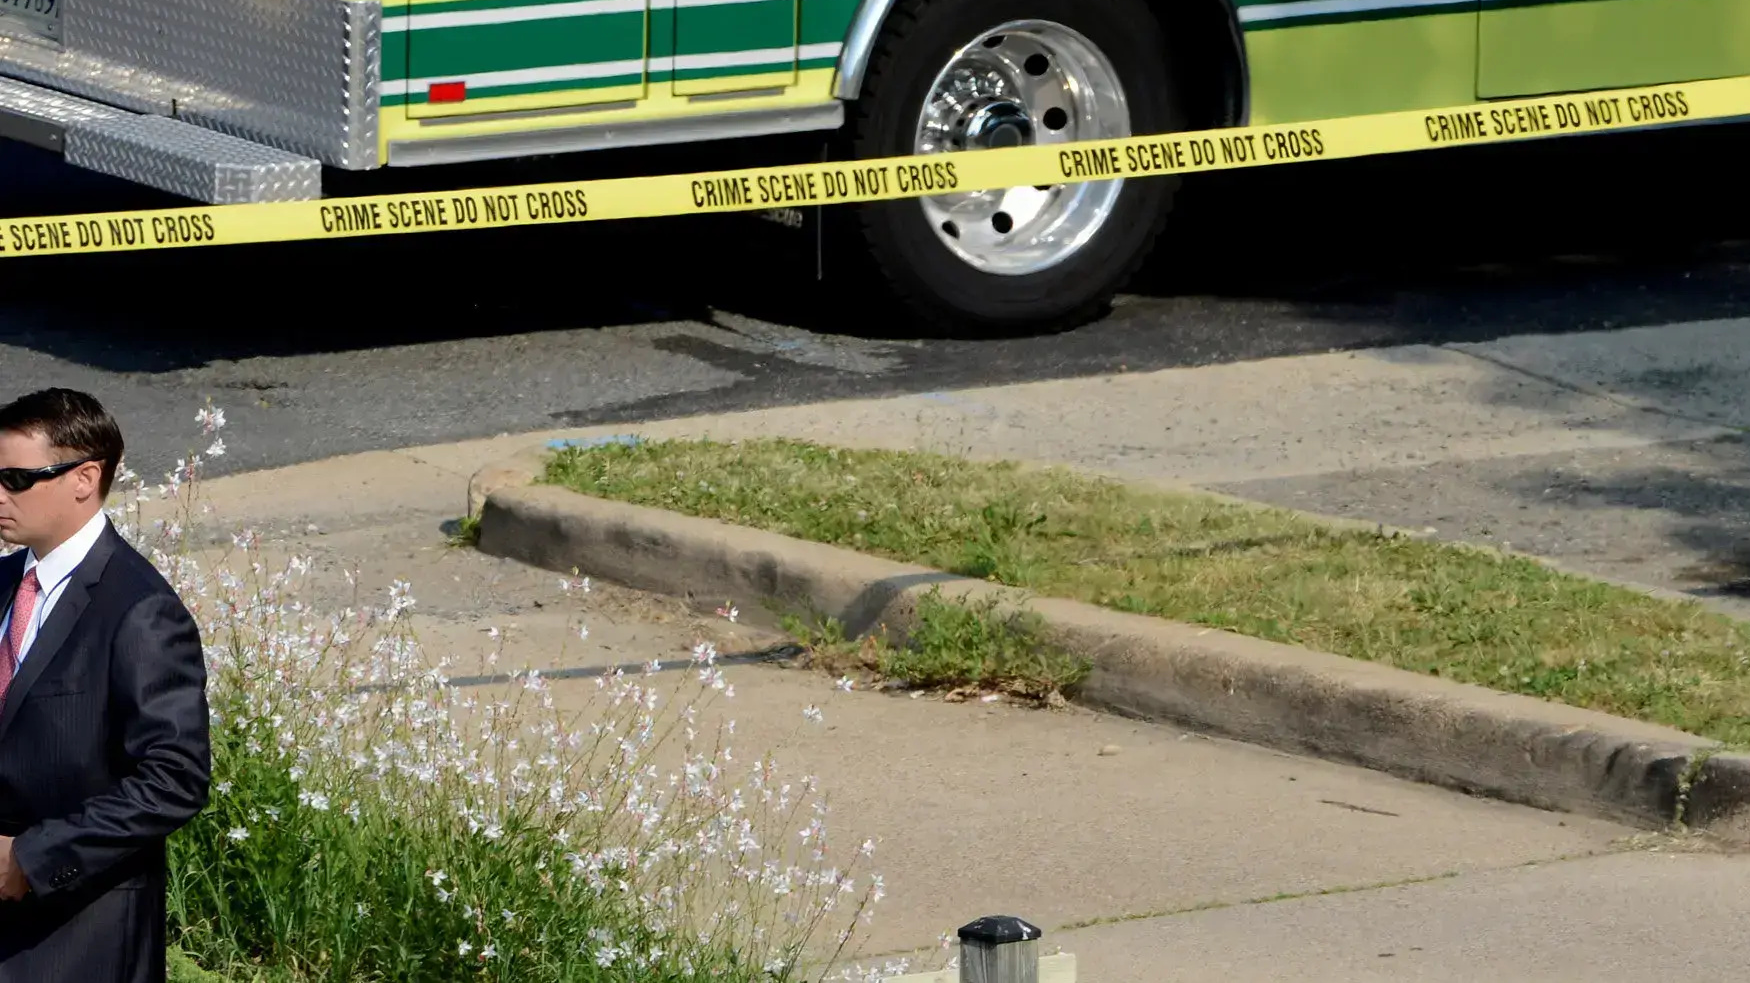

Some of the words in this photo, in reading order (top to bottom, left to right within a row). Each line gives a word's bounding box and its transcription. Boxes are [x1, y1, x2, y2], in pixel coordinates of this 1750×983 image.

[1424, 111, 1487, 142] CRIME
[1490, 104, 1550, 135] SCENE
[1553, 102, 1580, 129] DO
[1585, 97, 1622, 126] NOT
[1627, 91, 1689, 122] CROSS
[1059, 147, 1121, 178] CRIME
[1126, 141, 1185, 172] SCENE
[1190, 139, 1215, 166] DO
[1221, 135, 1257, 163] NOT
[1263, 129, 1324, 159] CROSS
[691, 177, 753, 208] CRIME
[757, 172, 818, 203] SCENE
[822, 170, 848, 198] DO
[853, 167, 889, 196] NOT
[896, 161, 958, 193] CROSS
[10, 222, 72, 251] SCENE
[77, 220, 103, 248] DO
[107, 218, 145, 246] NOT
[152, 214, 215, 244] CROSS
[320, 203, 382, 233] CRIME
[387, 198, 448, 228] SCENE
[452, 196, 477, 224] DO
[482, 194, 519, 222] NOT
[525, 189, 588, 220] CROSS
